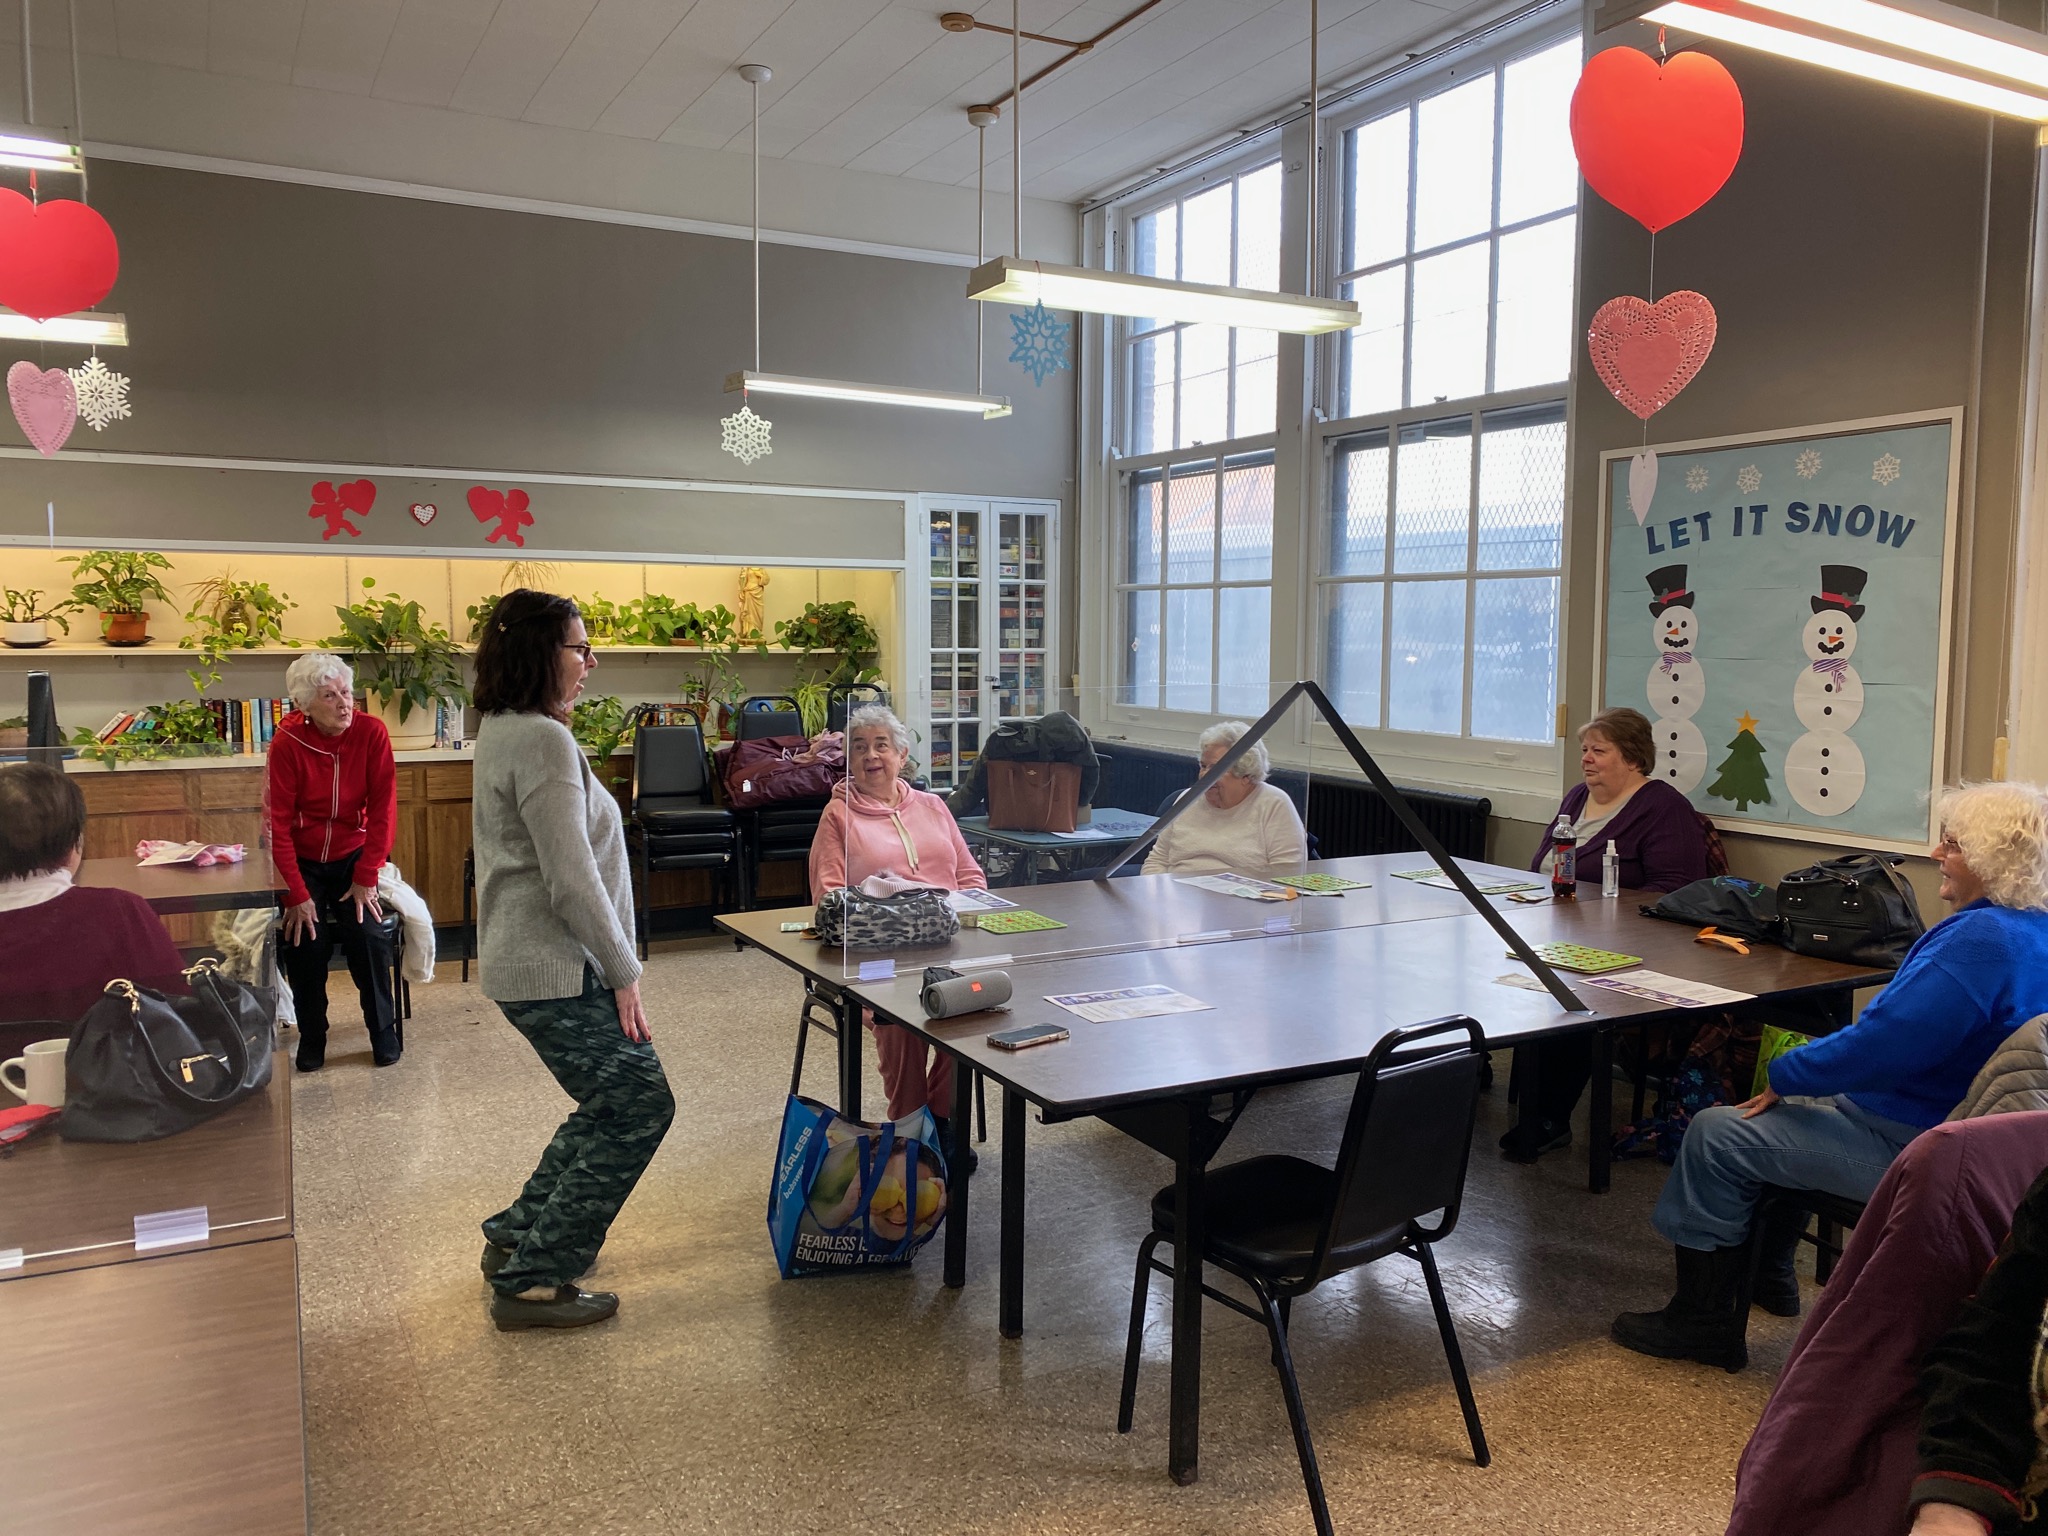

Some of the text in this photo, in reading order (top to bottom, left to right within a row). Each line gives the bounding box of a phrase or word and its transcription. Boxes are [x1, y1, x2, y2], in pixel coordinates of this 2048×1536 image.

[1646, 501, 1916, 554] LET IT SNOW
[799, 1233, 856, 1251] FEARLESS
[796, 1247, 853, 1265] ENJOYING
[855, 1255, 863, 1265] A
